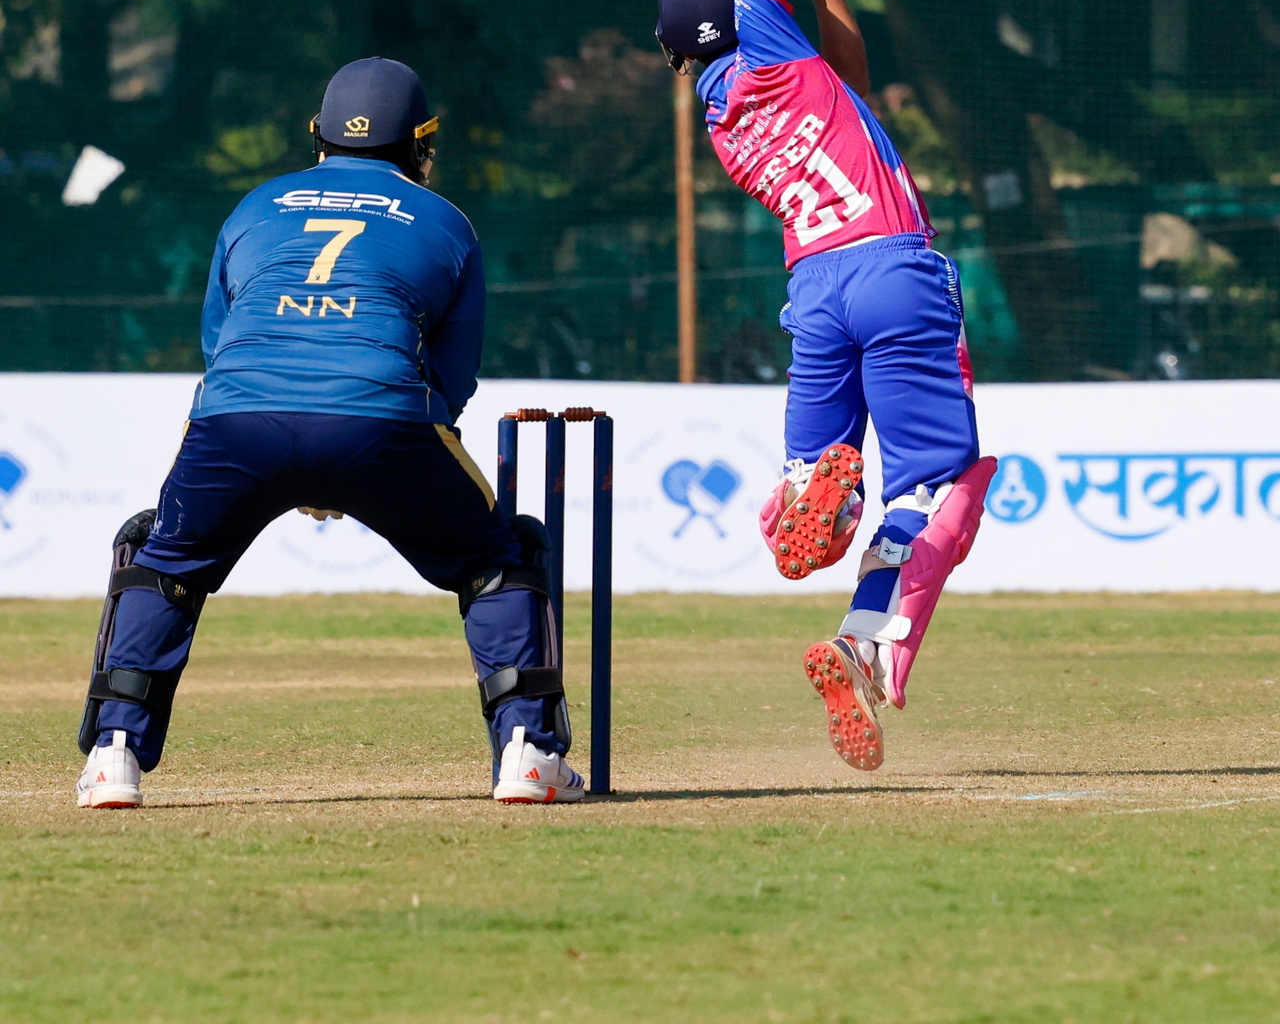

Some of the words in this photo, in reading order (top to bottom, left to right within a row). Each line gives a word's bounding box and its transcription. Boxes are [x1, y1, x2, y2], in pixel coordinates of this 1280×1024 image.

[736, 101, 778, 166] REPUBLIC
[272, 190, 415, 221] GEPL
[279, 206, 306, 214] GLOBAL
[348, 208, 382, 217] PREMIER
[382, 213, 412, 226] LEAGUE
[779, 146, 874, 247] 21
[303, 218, 366, 284] 7
[276, 295, 357, 318] NN
